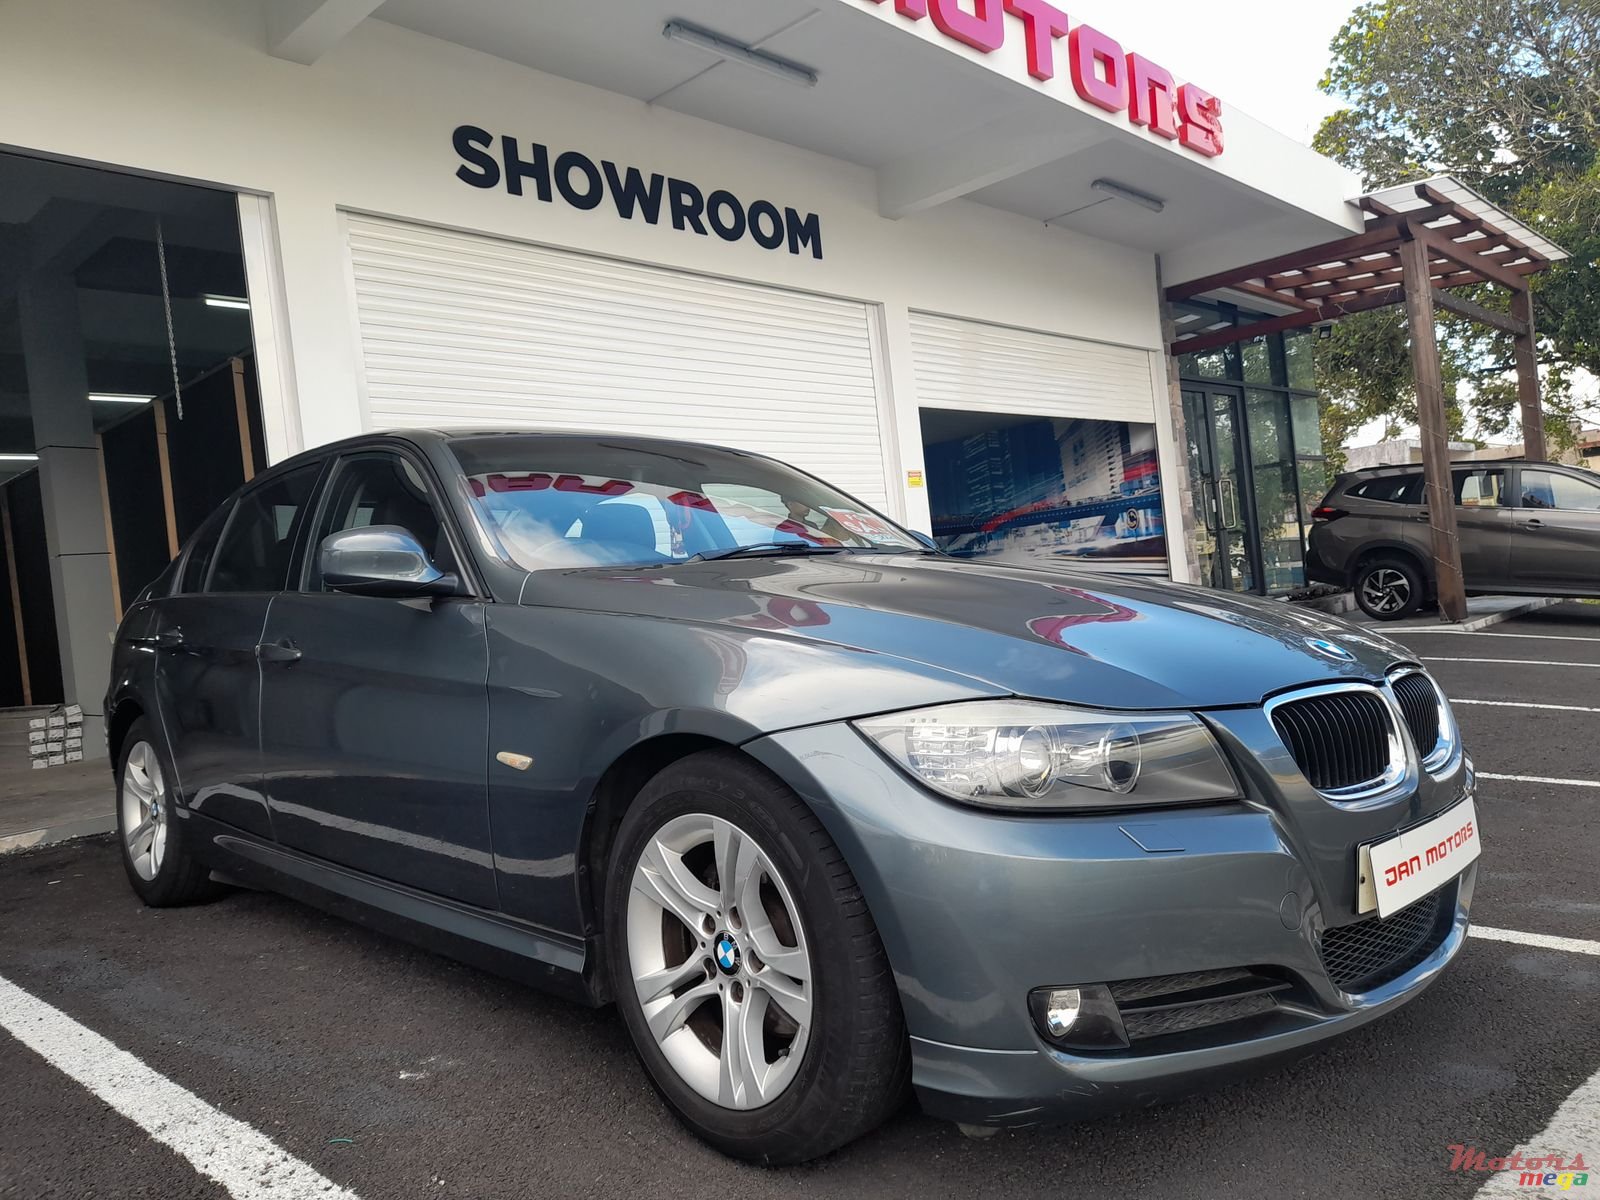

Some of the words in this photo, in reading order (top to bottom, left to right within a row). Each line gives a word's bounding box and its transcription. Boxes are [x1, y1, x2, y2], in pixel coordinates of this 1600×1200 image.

[862, 0, 1223, 157] OTORS
[452, 124, 823, 260] SHOWROOM
[1384, 854, 1421, 887] JAN
[1425, 821, 1474, 867] MOTORS
